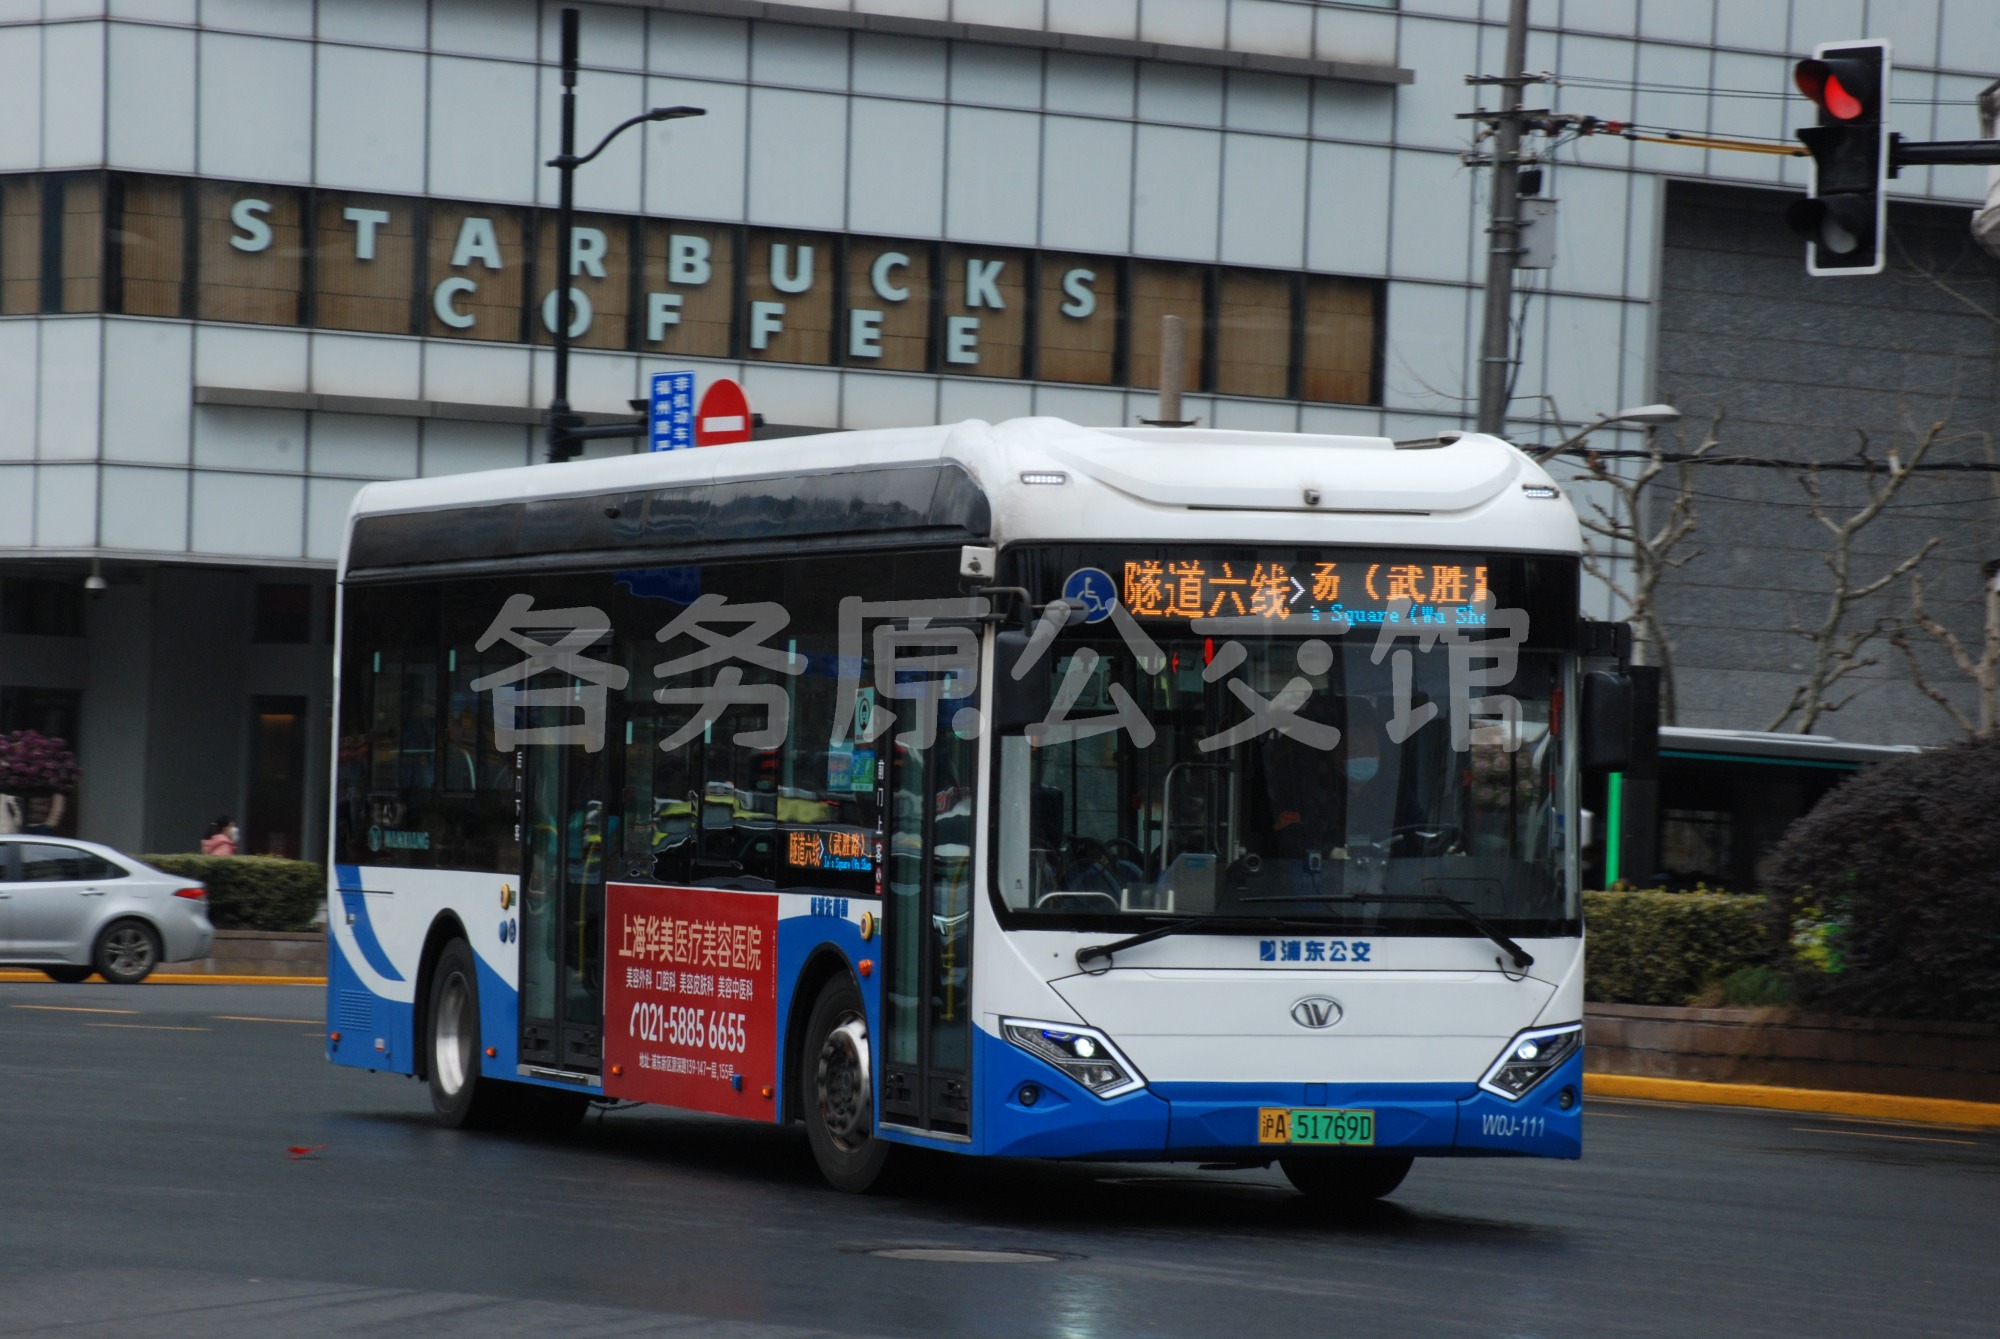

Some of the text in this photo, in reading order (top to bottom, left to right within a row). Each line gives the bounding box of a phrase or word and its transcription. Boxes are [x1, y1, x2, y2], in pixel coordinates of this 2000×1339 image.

[229, 198, 1097, 318] STARBUCKS
[433, 276, 980, 364] COFFEE
[1124, 560, 1291, 620] 隧道六线
[1331, 603, 1400, 626] Square
[618, 913, 762, 972] 上海华美医疗美容医院
[1280, 940, 1372, 963] 浦东公交
[625, 966, 753, 1001] 美容外科 口腔科 美容皮肤科 美容中医科
[639, 1002, 746, 1053] 021-5885 6655
